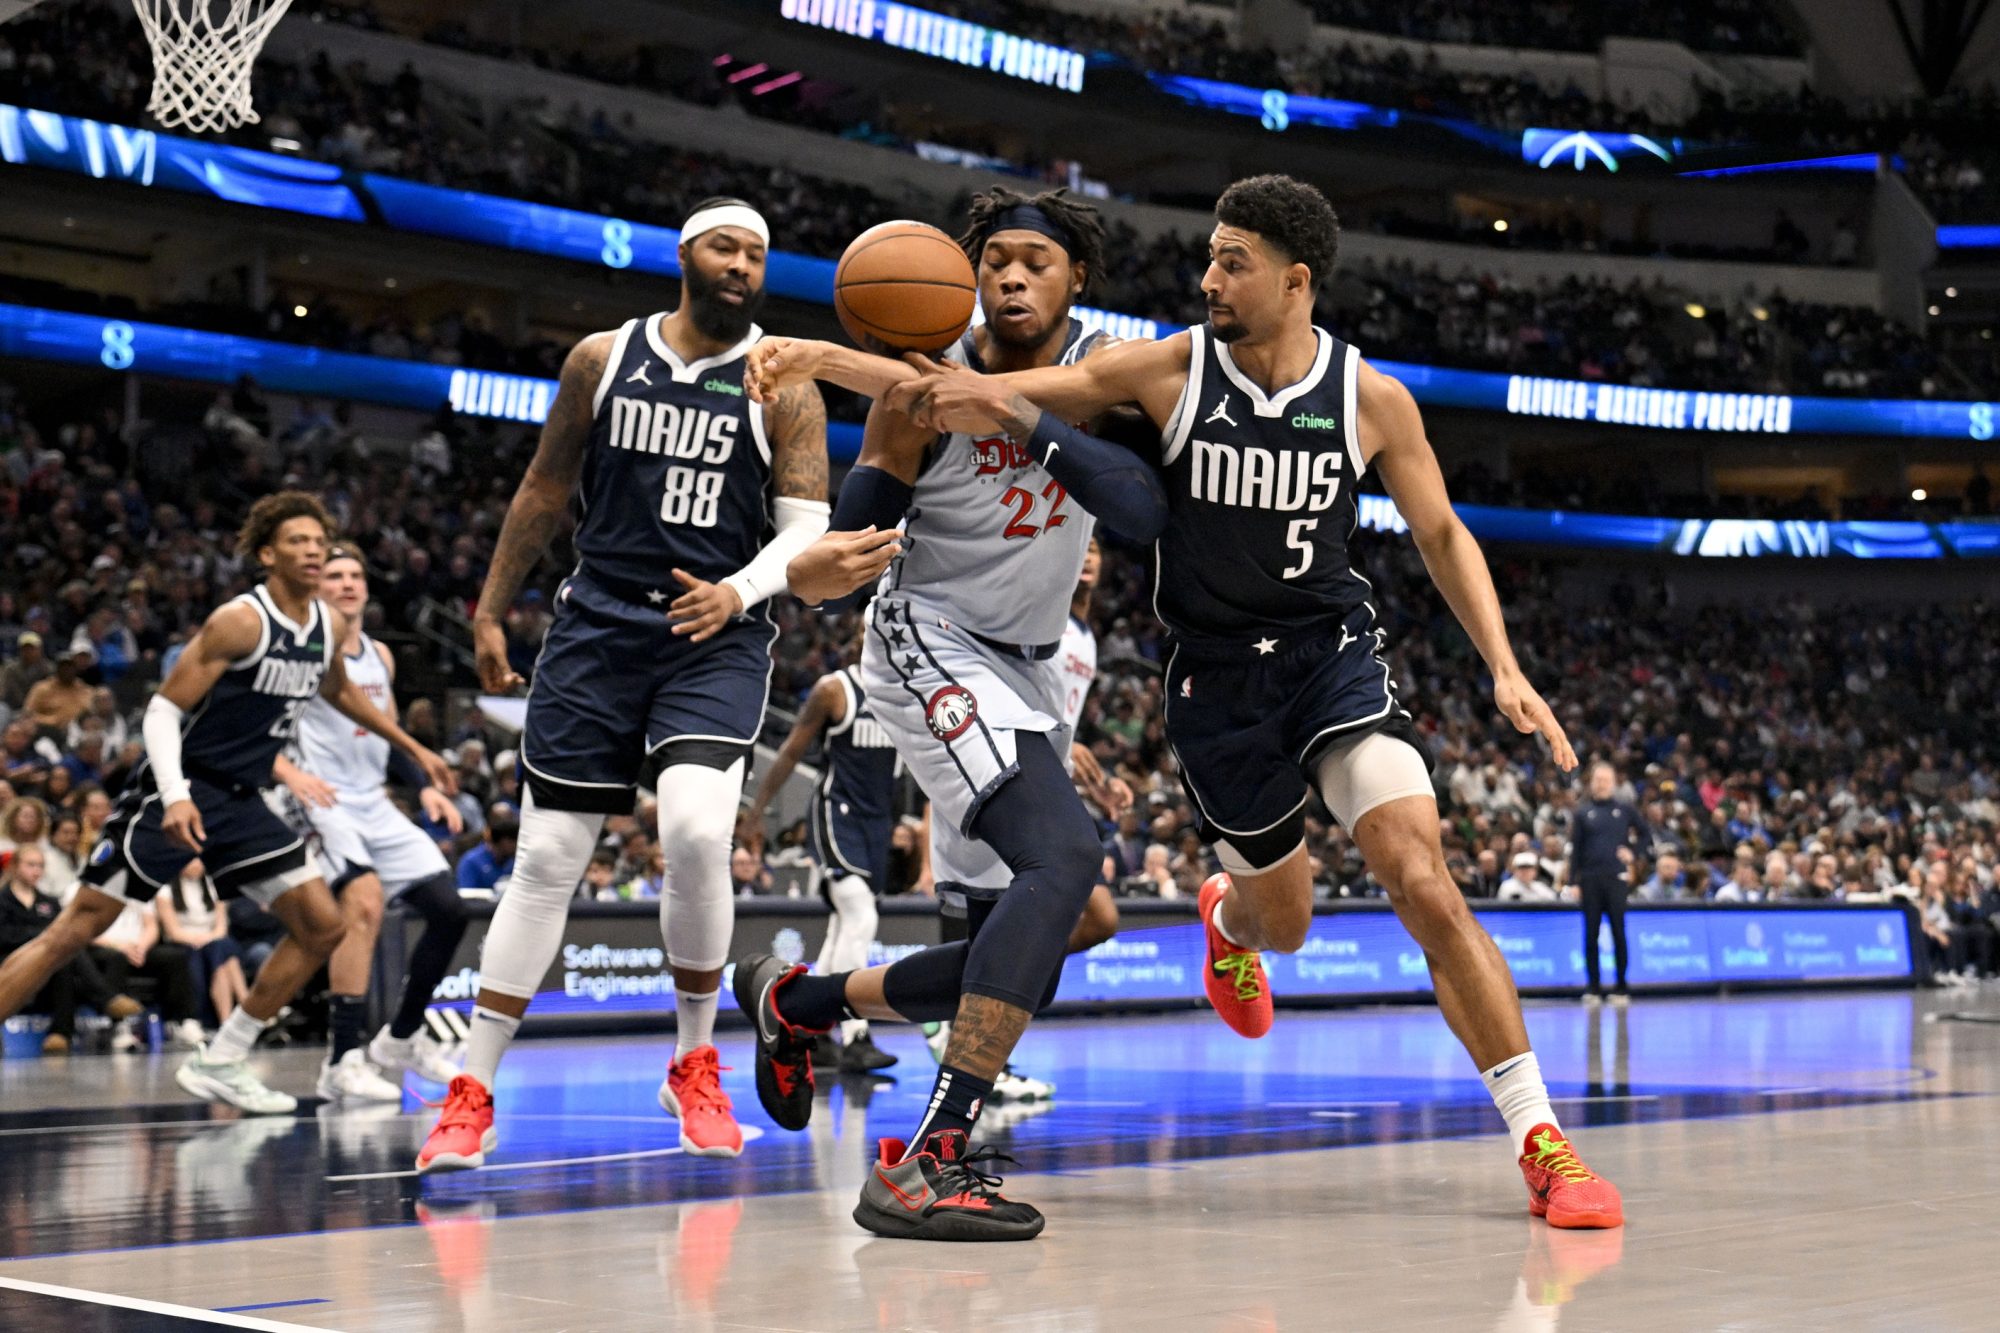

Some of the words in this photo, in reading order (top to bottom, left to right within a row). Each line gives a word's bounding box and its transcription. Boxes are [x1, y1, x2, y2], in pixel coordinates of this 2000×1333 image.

[1261, 89, 1289, 131] 8
[601, 218, 633, 269] 8
[101, 319, 135, 370] 8
[704, 378, 744, 397] chime
[609, 395, 739, 465] MAVS
[1291, 412, 1336, 431] chime
[1968, 401, 1994, 441] 8
[660, 465, 726, 528] 88
[1190, 439, 1343, 512] MAVS
[999, 478, 1069, 541] 22
[1282, 517, 1319, 580] 5
[563, 943, 664, 969] Software
[564, 971, 676, 1002] Engineerin
